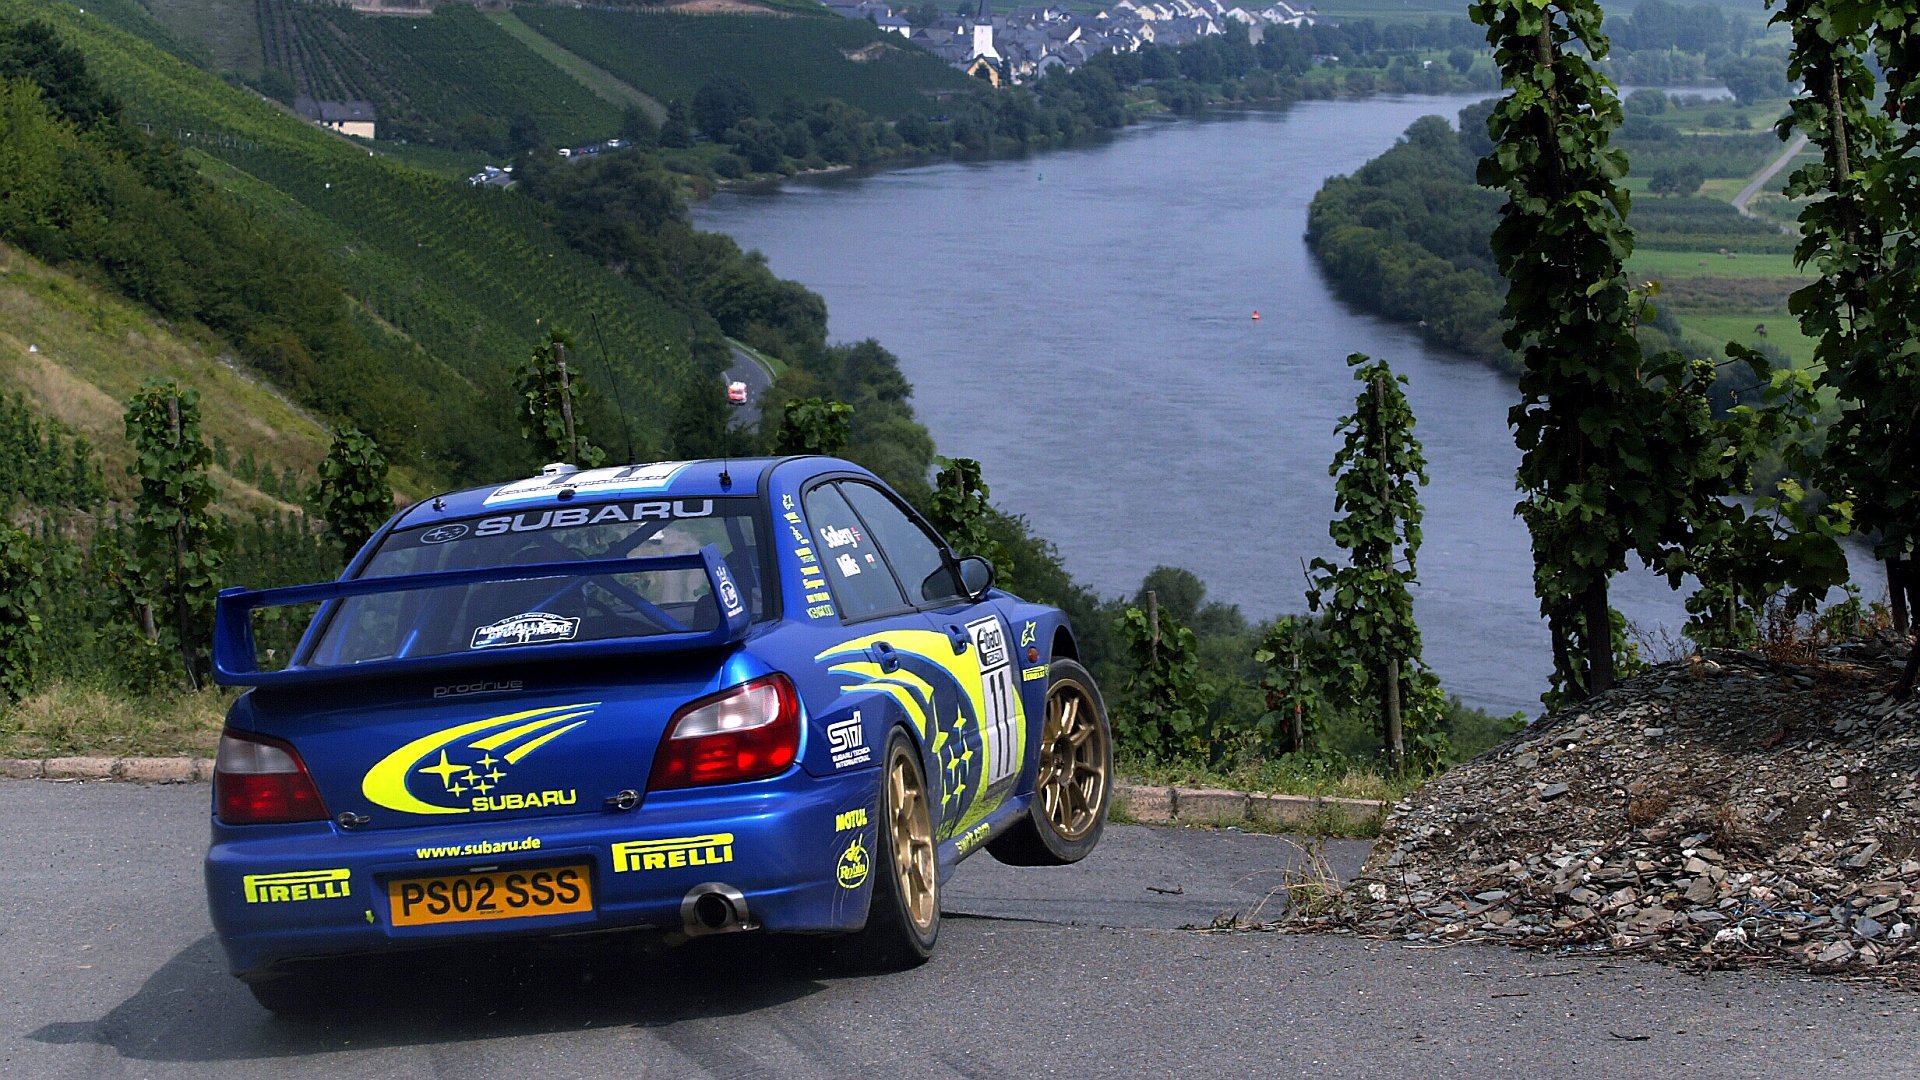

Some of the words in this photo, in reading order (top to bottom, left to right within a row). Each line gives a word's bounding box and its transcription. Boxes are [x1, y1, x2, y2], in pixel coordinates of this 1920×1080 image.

[475, 500, 713, 536] SUBARU
[820, 525, 858, 548] Solberg
[434, 680, 523, 698] prodrive
[989, 671, 1010, 778] 11
[472, 789, 577, 812] SUBARU
[836, 808, 868, 832] MOTUL
[416, 836, 541, 859] www.subaru.de
[611, 832, 734, 873] PIRELLI
[243, 868, 351, 903] PIRELLI
[401, 876, 496, 917] PS02
[505, 869, 581, 908] SSS
